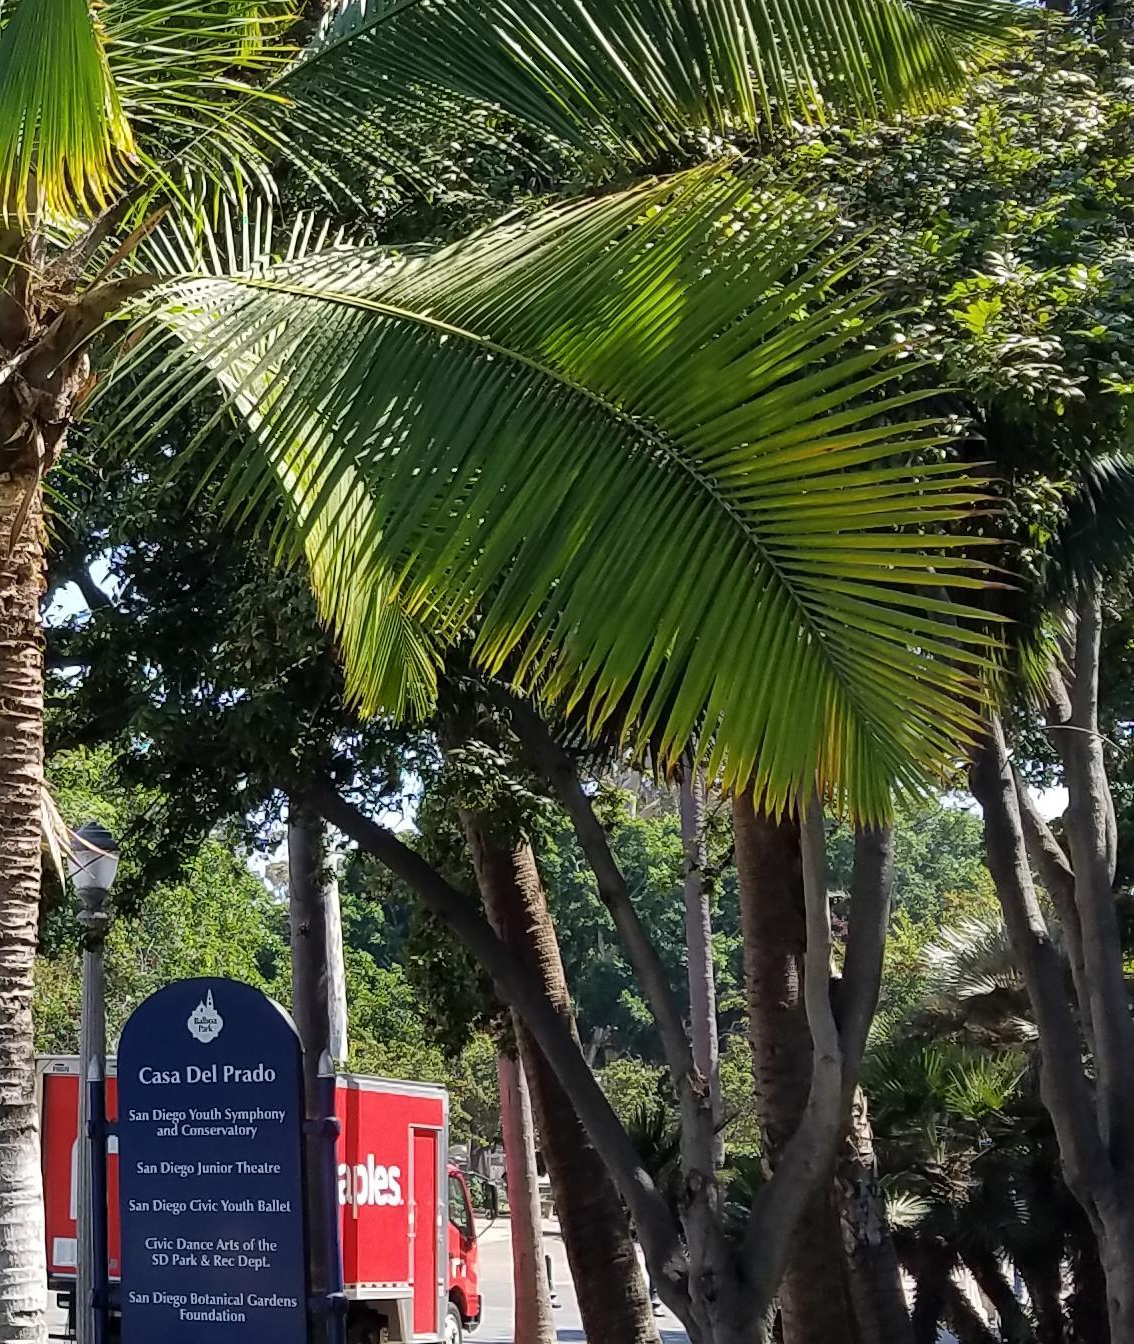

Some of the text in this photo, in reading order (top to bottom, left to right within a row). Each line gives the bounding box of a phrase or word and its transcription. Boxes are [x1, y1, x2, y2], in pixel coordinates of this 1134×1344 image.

[139, 1063, 275, 1084] Casa Del Prado
[129, 1107, 285, 1124] San Diego Youth Symphony
[157, 1124, 257, 1139] and Conservatory
[137, 1161, 280, 1177] San Diego Junior Theatre
[129, 1199, 291, 1215] San Diego Civic Youth Ballet
[145, 1237, 277, 1251] Civic Dance Arts of the
[152, 1253, 270, 1271] SD Park & Rec Dept.
[129, 1291, 297, 1308] San Diego Botanical Gardens
[180, 1308, 245, 1322] Foundation
